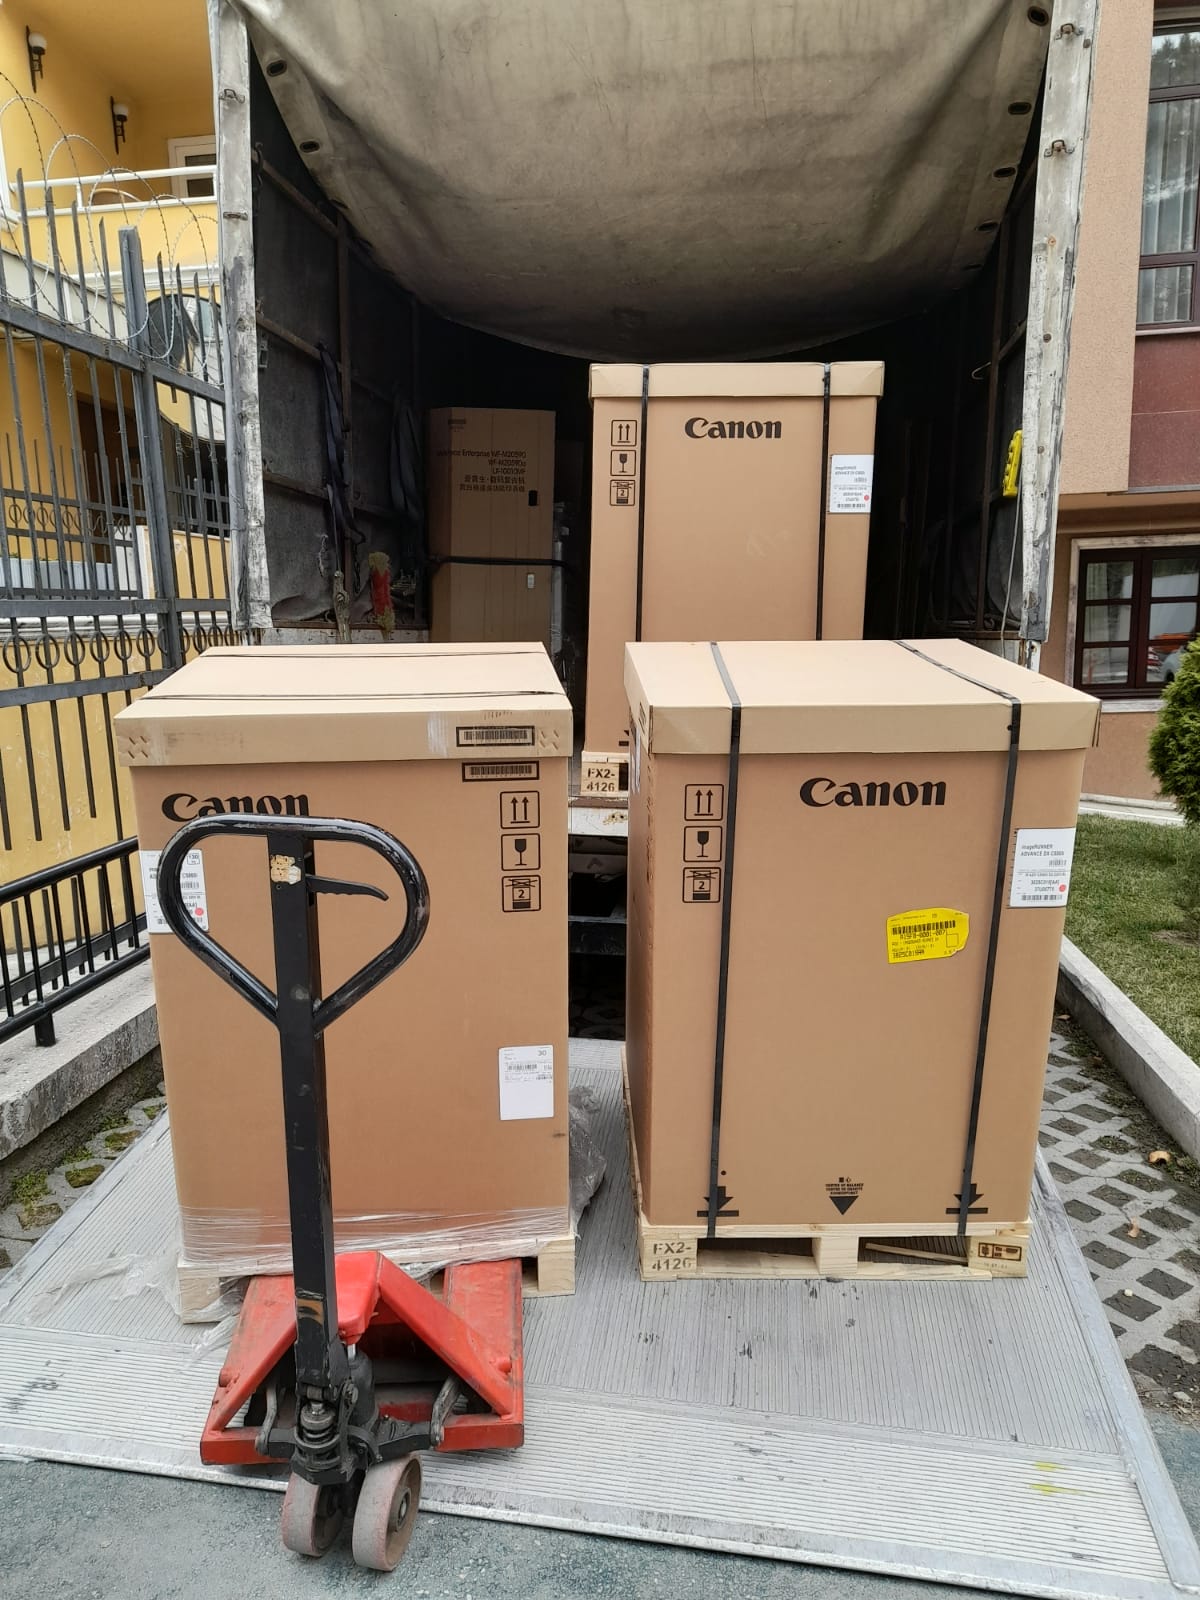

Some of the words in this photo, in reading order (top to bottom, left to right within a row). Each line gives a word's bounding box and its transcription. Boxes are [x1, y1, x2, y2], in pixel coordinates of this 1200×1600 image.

[684, 417, 782, 439] Canon
[587, 768, 615, 779] FX2-
[587, 782, 615, 792] 4126
[799, 777, 947, 807] Canon
[162, 793, 309, 822] Canon
[653, 1241, 692, 1254] FX2-
[652, 1257, 691, 1271] 4126
